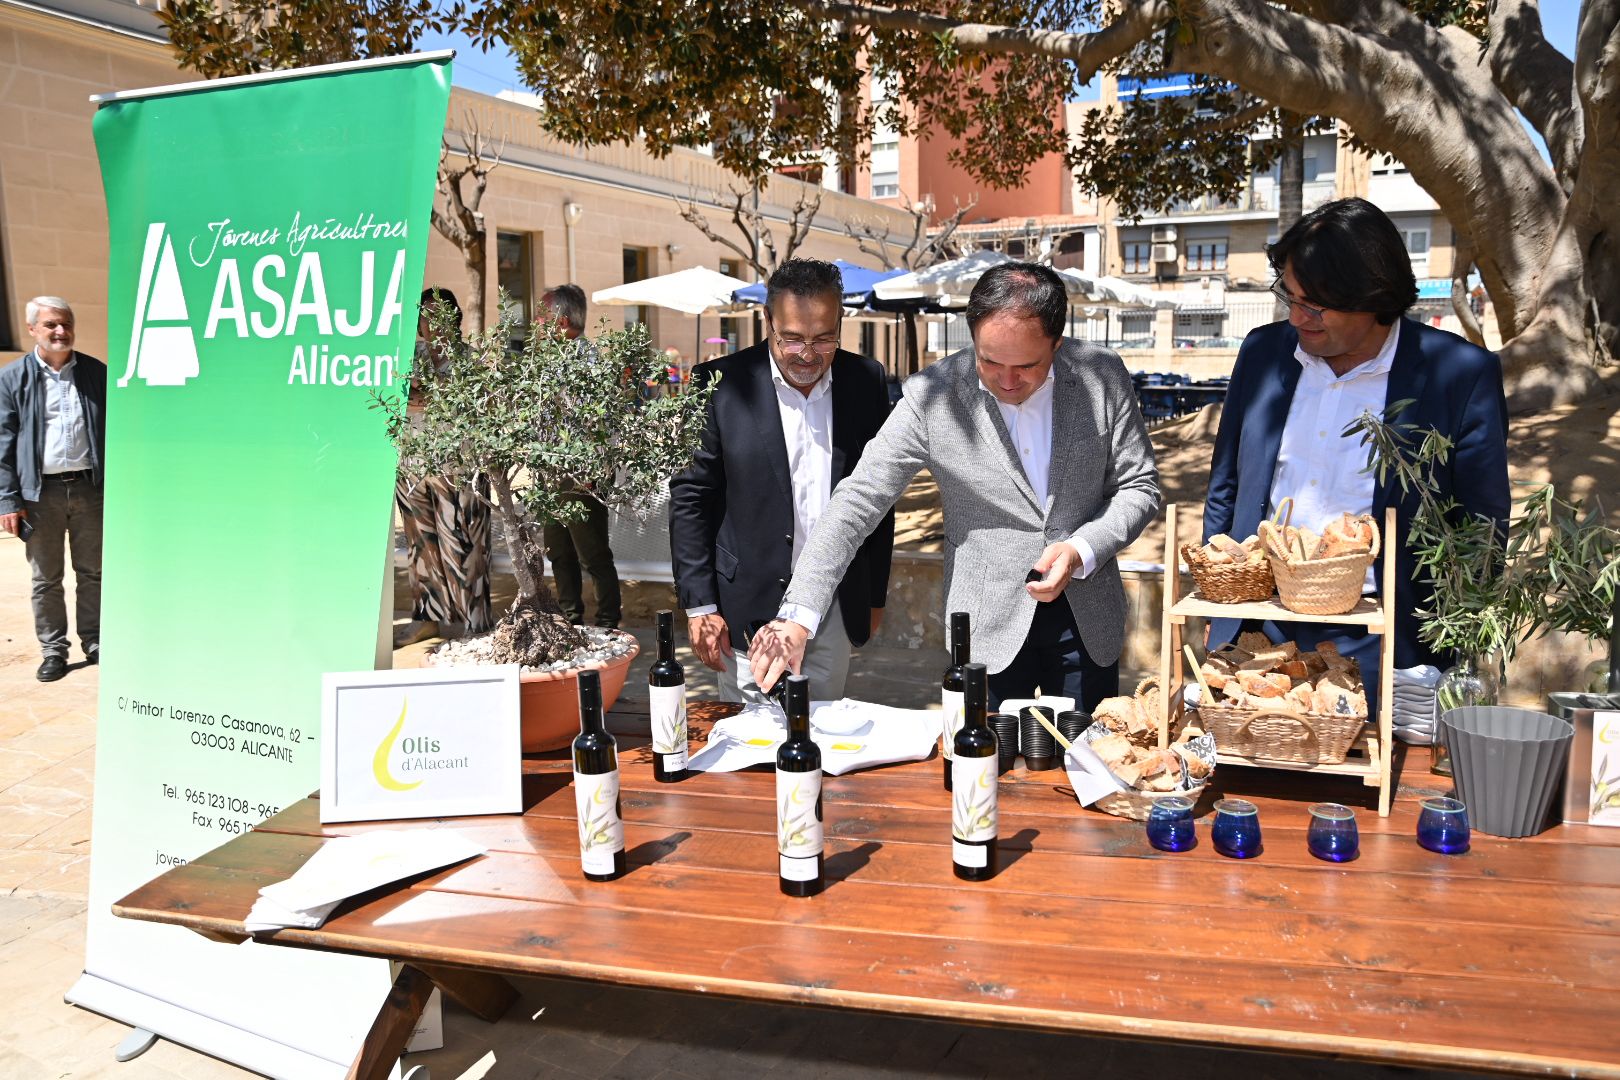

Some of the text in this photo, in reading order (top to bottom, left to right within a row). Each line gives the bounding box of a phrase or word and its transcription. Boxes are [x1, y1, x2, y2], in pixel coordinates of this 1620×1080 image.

[188, 218, 281, 267] Jóvenes
[118, 696, 128, 712] C/
[132, 700, 164, 718] Pintor
[170, 706, 215, 726] Lorenzo
[221, 714, 287, 740] Casanova,
[289, 728, 301, 743] 62
[191, 731, 293, 763] 03003 ALICANTE
[402, 736, 441, 755] Olis
[401, 756, 469, 772] d'Alacant
[163, 784, 180, 799] Tel.
[192, 811, 213, 828] Fax
